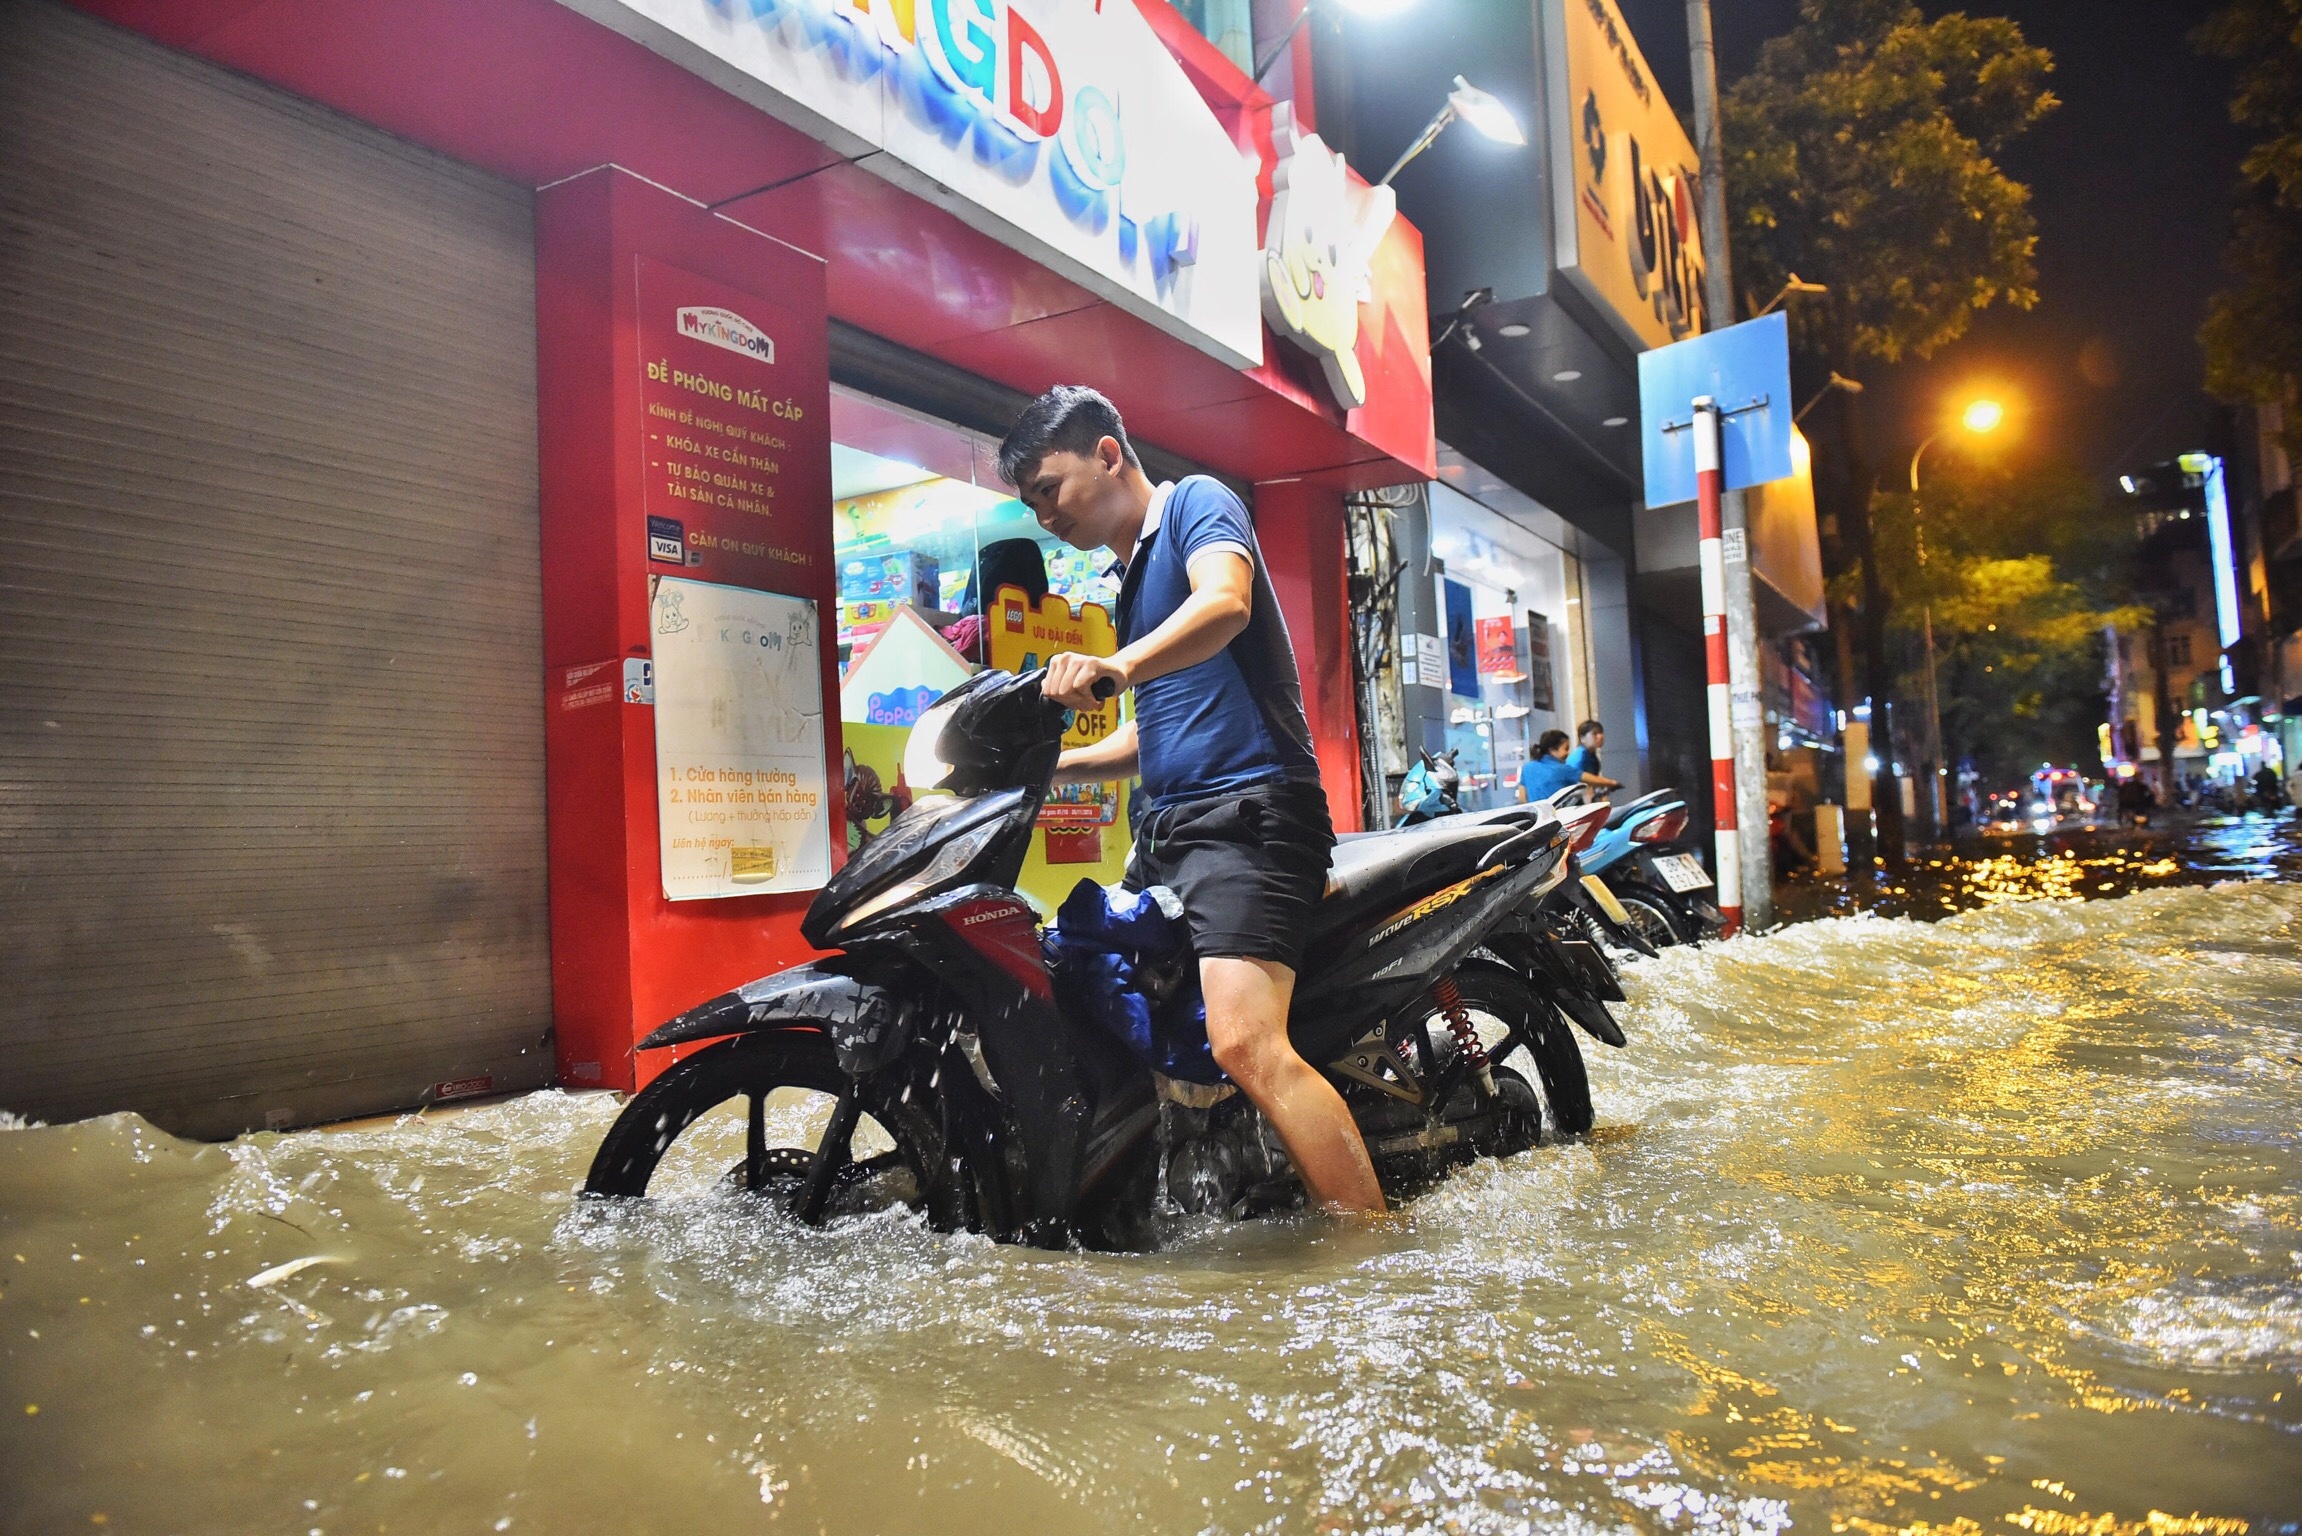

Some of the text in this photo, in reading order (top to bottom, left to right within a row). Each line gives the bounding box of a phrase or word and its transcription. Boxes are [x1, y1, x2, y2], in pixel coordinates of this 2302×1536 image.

[683, 312, 769, 358] MYKINGDOM
[647, 358, 804, 422] ĐỀ PHÒNG MẤT CẮP
[649, 402, 676, 422] KÍNH
[696, 416, 724, 436] NGHỊ
[726, 425, 748, 440] QUÝ
[750, 431, 786, 450] KHÁCH
[666, 434, 702, 454] KHÓA
[705, 446, 720, 460] XE
[722, 446, 748, 467] CẨN
[750, 456, 780, 475] THẬN
[666, 462, 682, 480] TỰ
[684, 465, 710, 482] BẢO
[714, 472, 748, 492] QUẢN
[750, 482, 764, 496] XE
[766, 486, 776, 498] &
[667, 482, 687, 499] TÀI
[690, 486, 714, 504] SẢN
[717, 494, 734, 508] CÁ
[656, 541, 678, 555] VISA
[689, 530, 718, 549] CẢM
[742, 543, 766, 557] QUÝ
[1007, 609, 1022, 624] LEGO
[1066, 628, 1083, 646] ĐẾN
[870, 696, 916, 726] Peppa
[1076, 712, 1106, 738] OFF
[670, 765, 796, 787] 1. Cửa hàng trưởng
[670, 788, 816, 806] 2. Nhân viên bán hàng
[736, 810, 771, 824] thưởng
[774, 808, 792, 824] hấp
[672, 838, 692, 849] Liên
[694, 837, 706, 850] hệ
[964, 906, 1020, 926] HONDA
